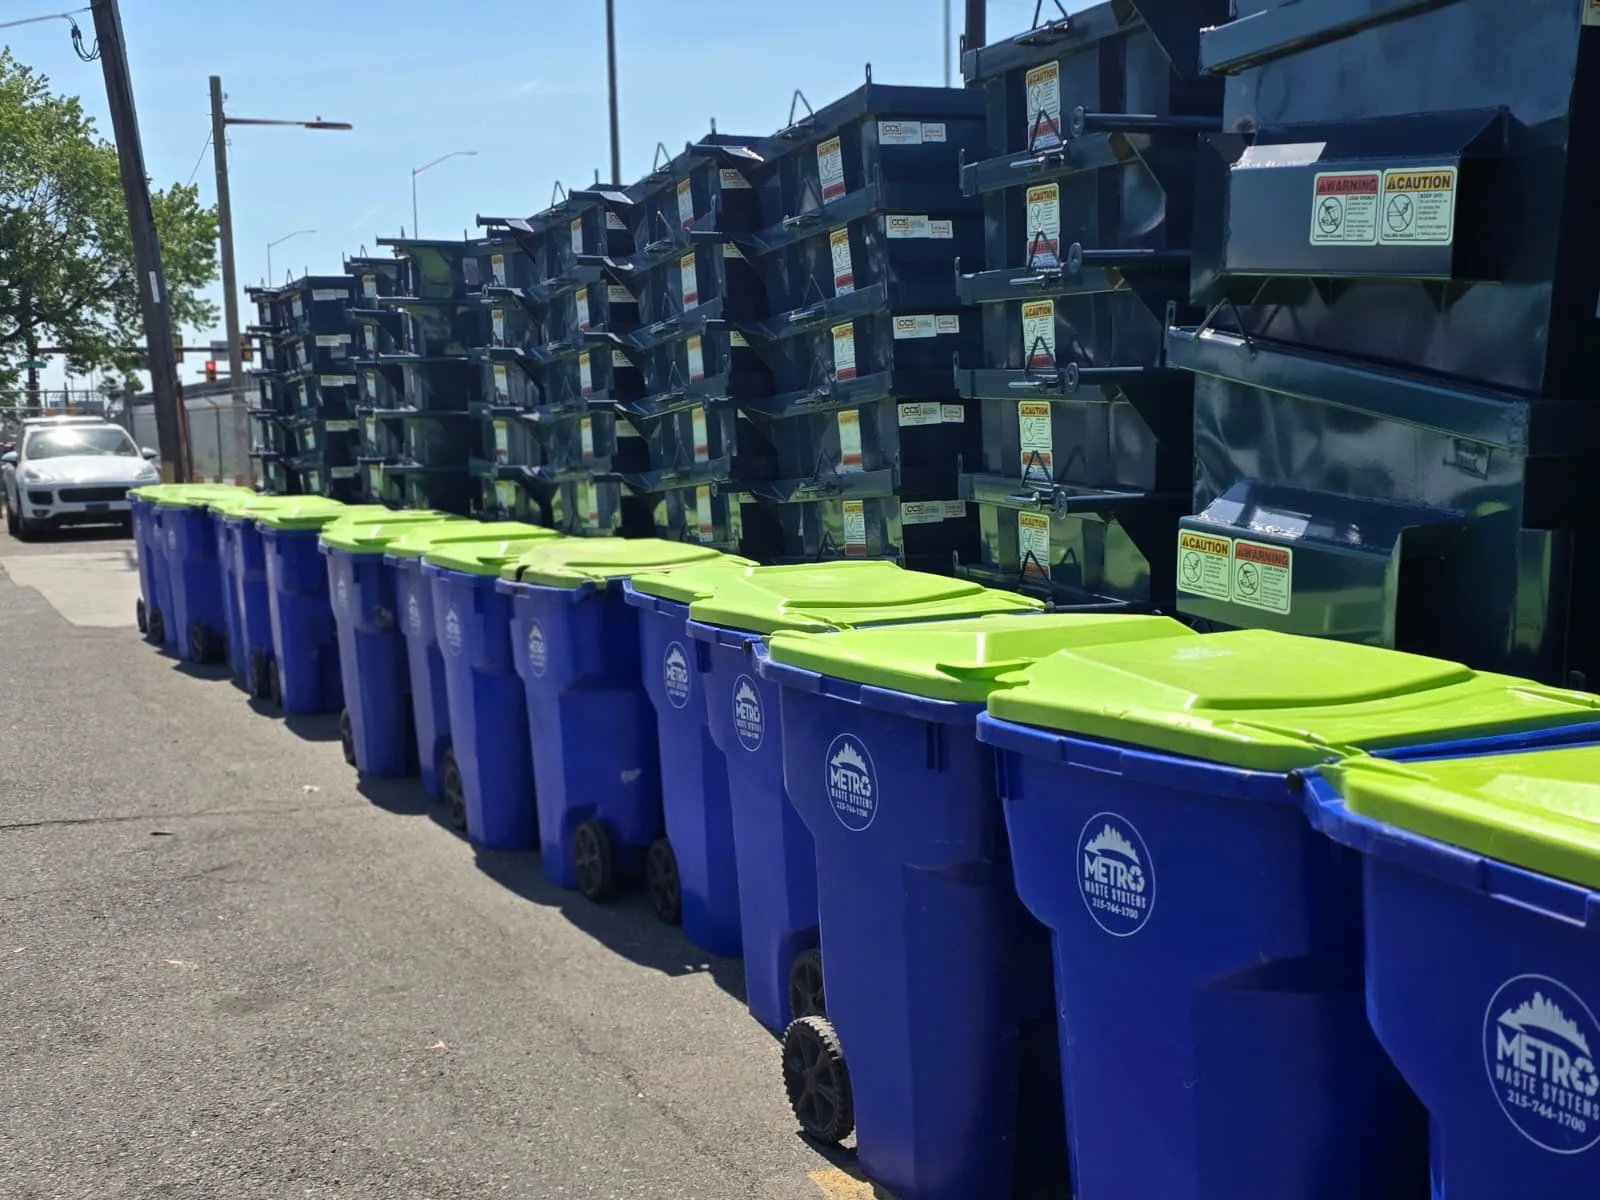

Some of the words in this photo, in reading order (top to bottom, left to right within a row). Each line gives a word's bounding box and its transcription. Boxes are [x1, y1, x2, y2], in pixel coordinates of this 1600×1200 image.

[1326, 178, 1377, 193] WARNING
[1395, 175, 1451, 189] CAUTION
[1033, 189, 1056, 201] CAUTION
[1029, 305, 1051, 317] CAUTION
[899, 319, 914, 327] CCS
[904, 406, 919, 414] CCS
[1025, 405, 1048, 415] CAUTION
[906, 504, 922, 513] CCS
[1025, 515, 1047, 528] CAUTION
[1189, 537, 1228, 554] CAUTION
[1243, 548, 1288, 565] WARNING
[830, 765, 871, 797] METRO
[1084, 852, 1145, 893] METRO
[1084, 880, 1109, 899] WASTE
[1111, 888, 1146, 909] SYSTEMS
[1092, 897, 1138, 919] 215-744-1700
[1497, 1025, 1599, 1097] METRO
[1496, 1063, 1536, 1095] WASTE
[1542, 1082, 1600, 1121] SYSTEMS
[1507, 1089, 1586, 1133] 215-744-1700
